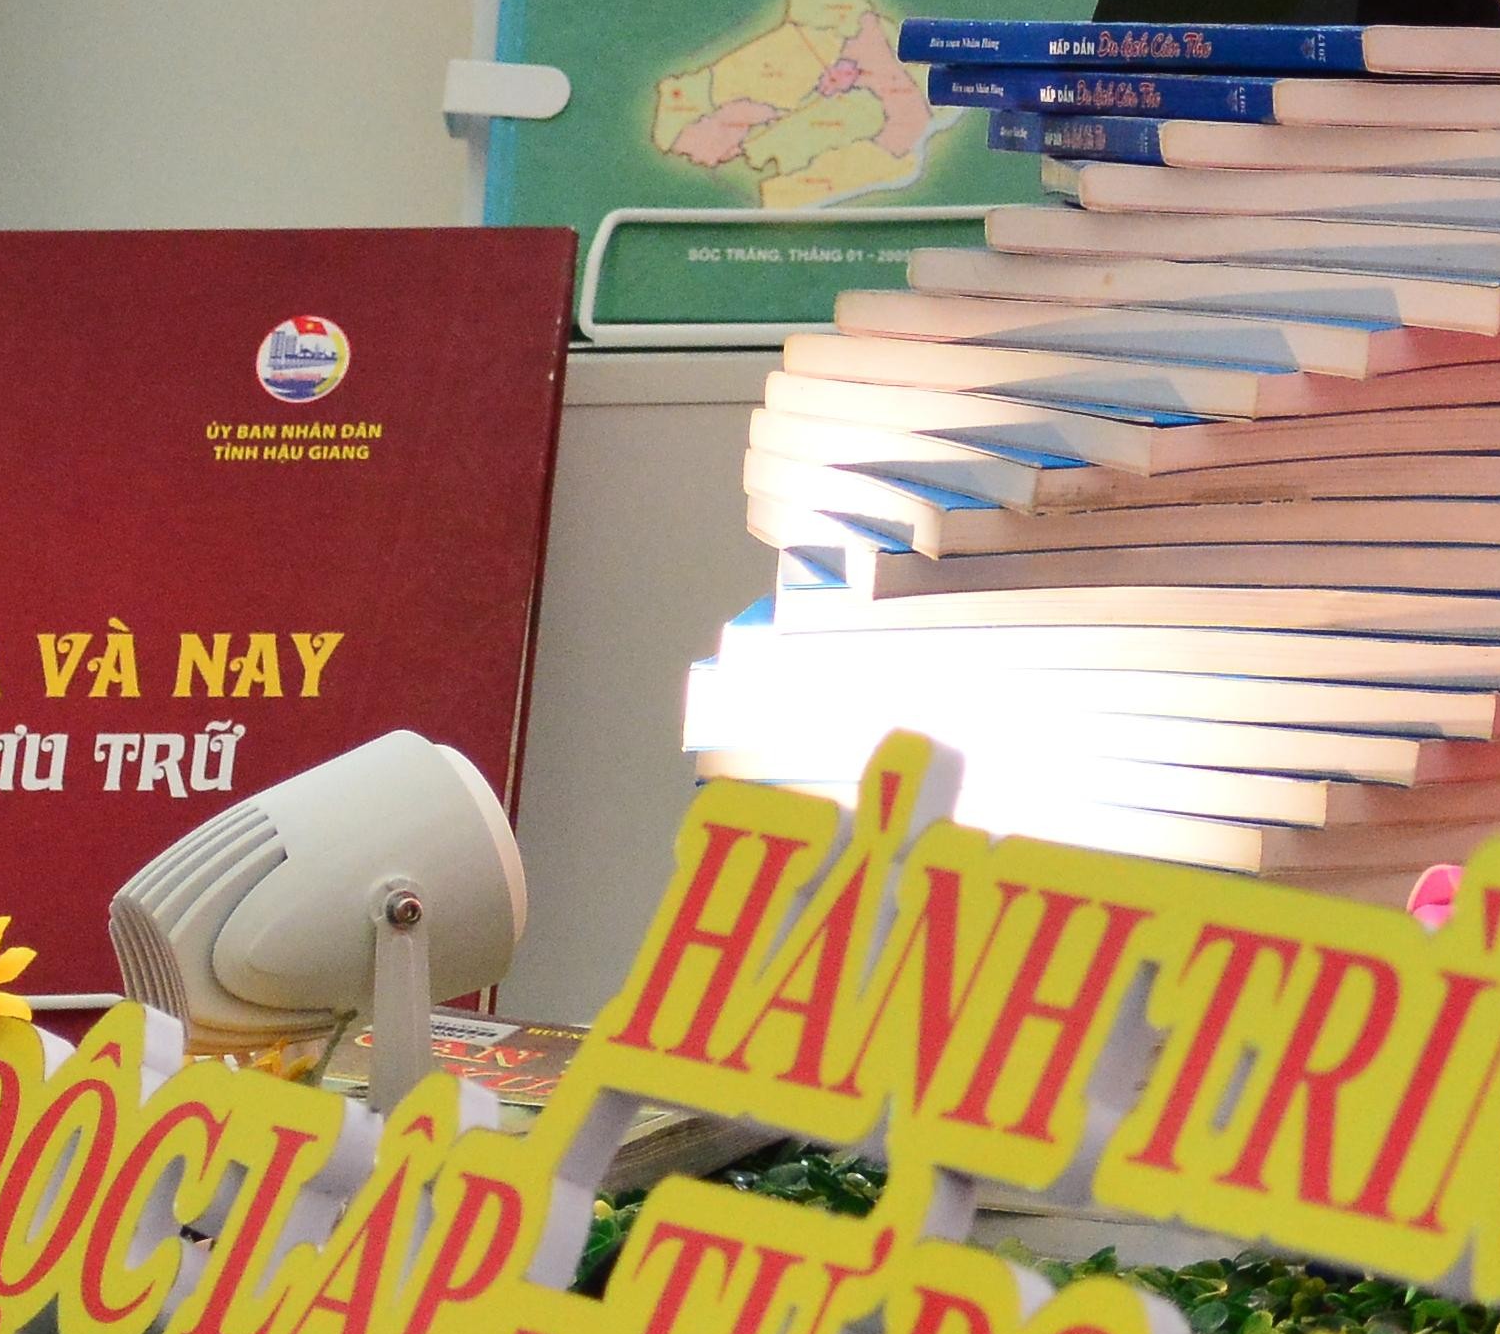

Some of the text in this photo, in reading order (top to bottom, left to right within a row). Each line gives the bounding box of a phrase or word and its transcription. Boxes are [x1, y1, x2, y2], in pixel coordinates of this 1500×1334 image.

[1049, 38, 1070, 55] HẤP
[1097, 31, 1119, 57] Du
[206, 420, 383, 440] ỦY BAN NHÂN DÂN
[213, 442, 370, 464] TỈNH HẬU GIANG
[37, 614, 142, 699] VÀ
[172, 631, 346, 699] NAY
[92, 719, 245, 799] TRỮ
[610, 770, 1150, 1144] HÀNH
